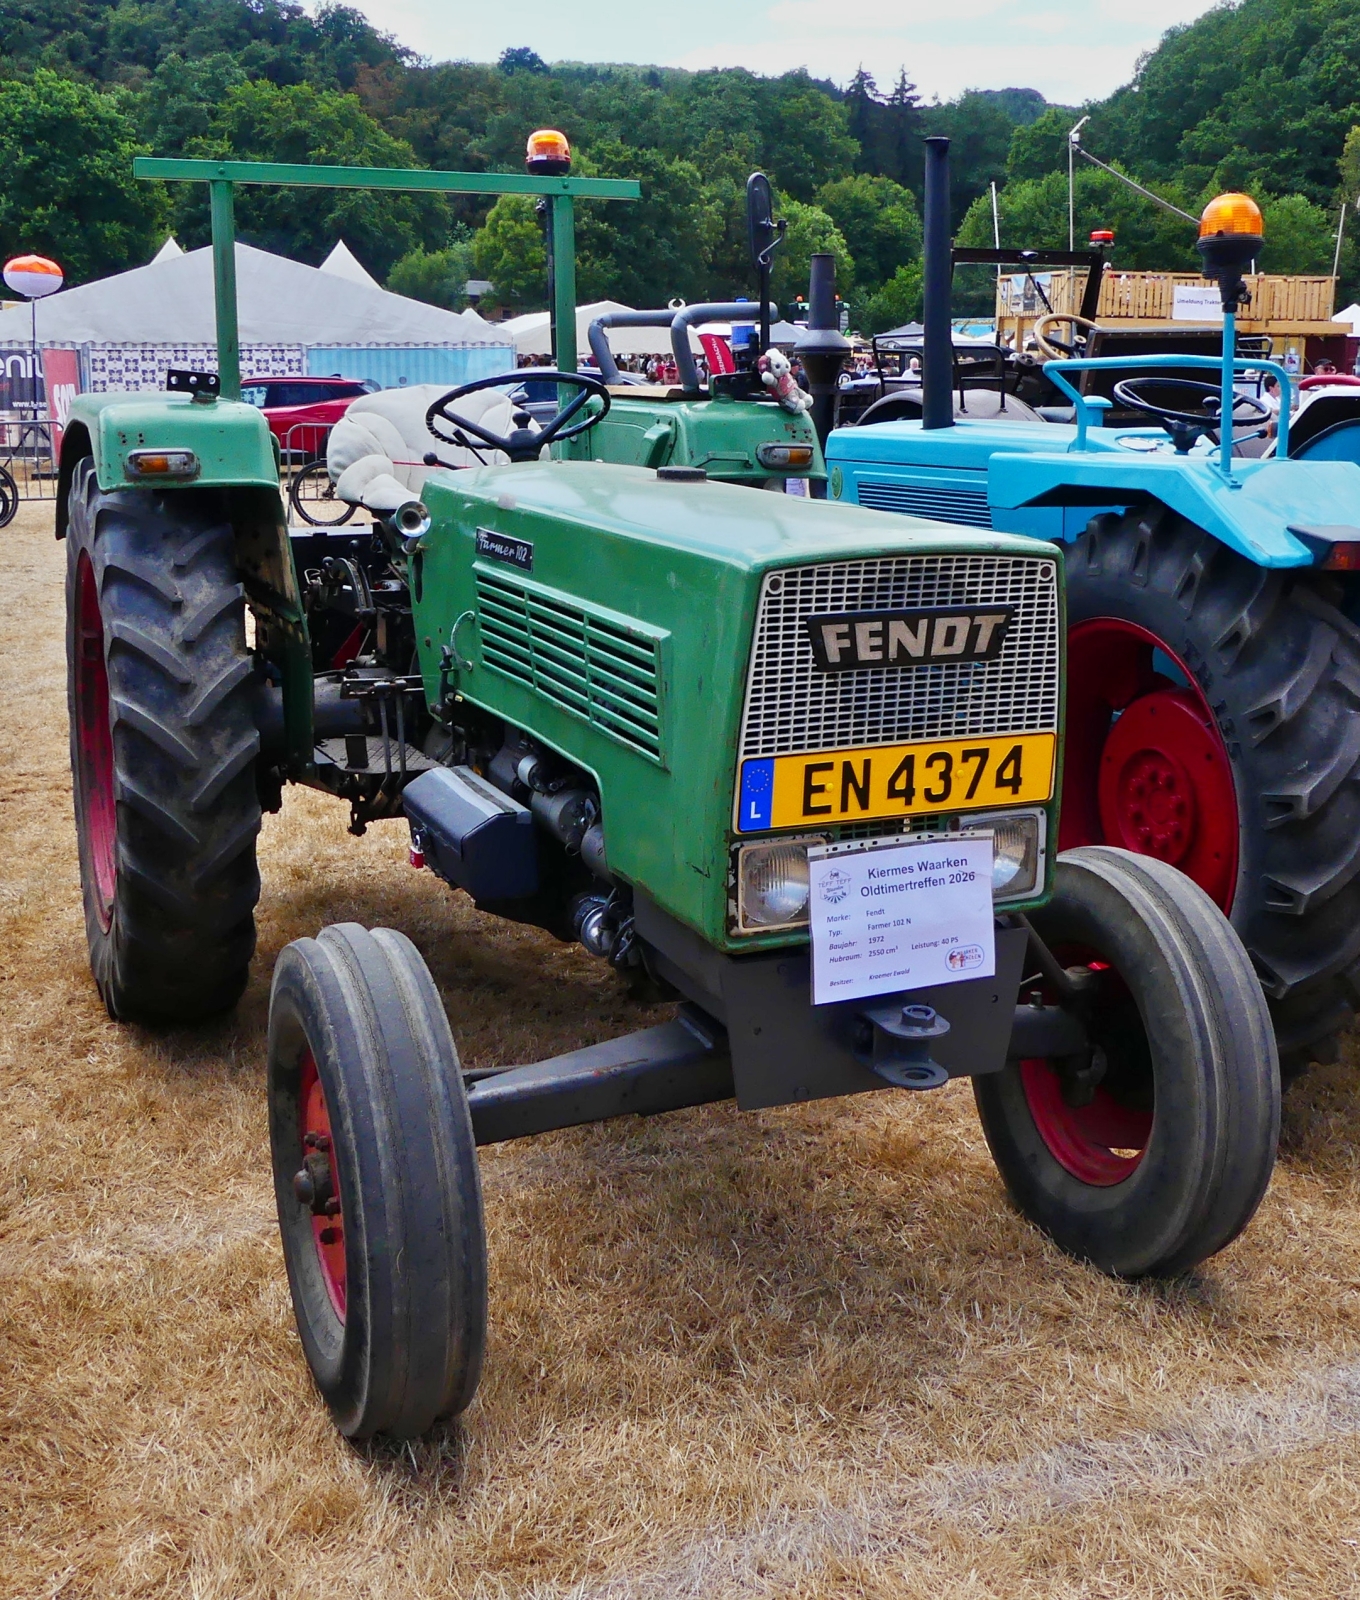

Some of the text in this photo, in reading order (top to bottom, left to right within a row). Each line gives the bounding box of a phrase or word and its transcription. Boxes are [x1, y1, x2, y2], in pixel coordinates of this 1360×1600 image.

[479, 533, 528, 562] Farmer 102
[821, 614, 1007, 663] FENDT
[802, 744, 1023, 817] EN 4374
[750, 801, 761, 819] L
[867, 858, 968, 880] Kiermes Waarken
[860, 871, 976, 898] Oldtimertreffen 2026
[826, 908, 885, 923] Marke: Fendt
[828, 929, 843, 938] Typ:
[867, 922, 891, 931] Farmer
[893, 919, 905, 927] 102
[828, 935, 885, 951] Baujahr: 1972
[828, 953, 862, 963] Hubraum:
[868, 948, 885, 957] 2550
[911, 940, 940, 950] Leistung:
[829, 979, 854, 987] Besitzer:
[893, 967, 910, 977] Ewald
